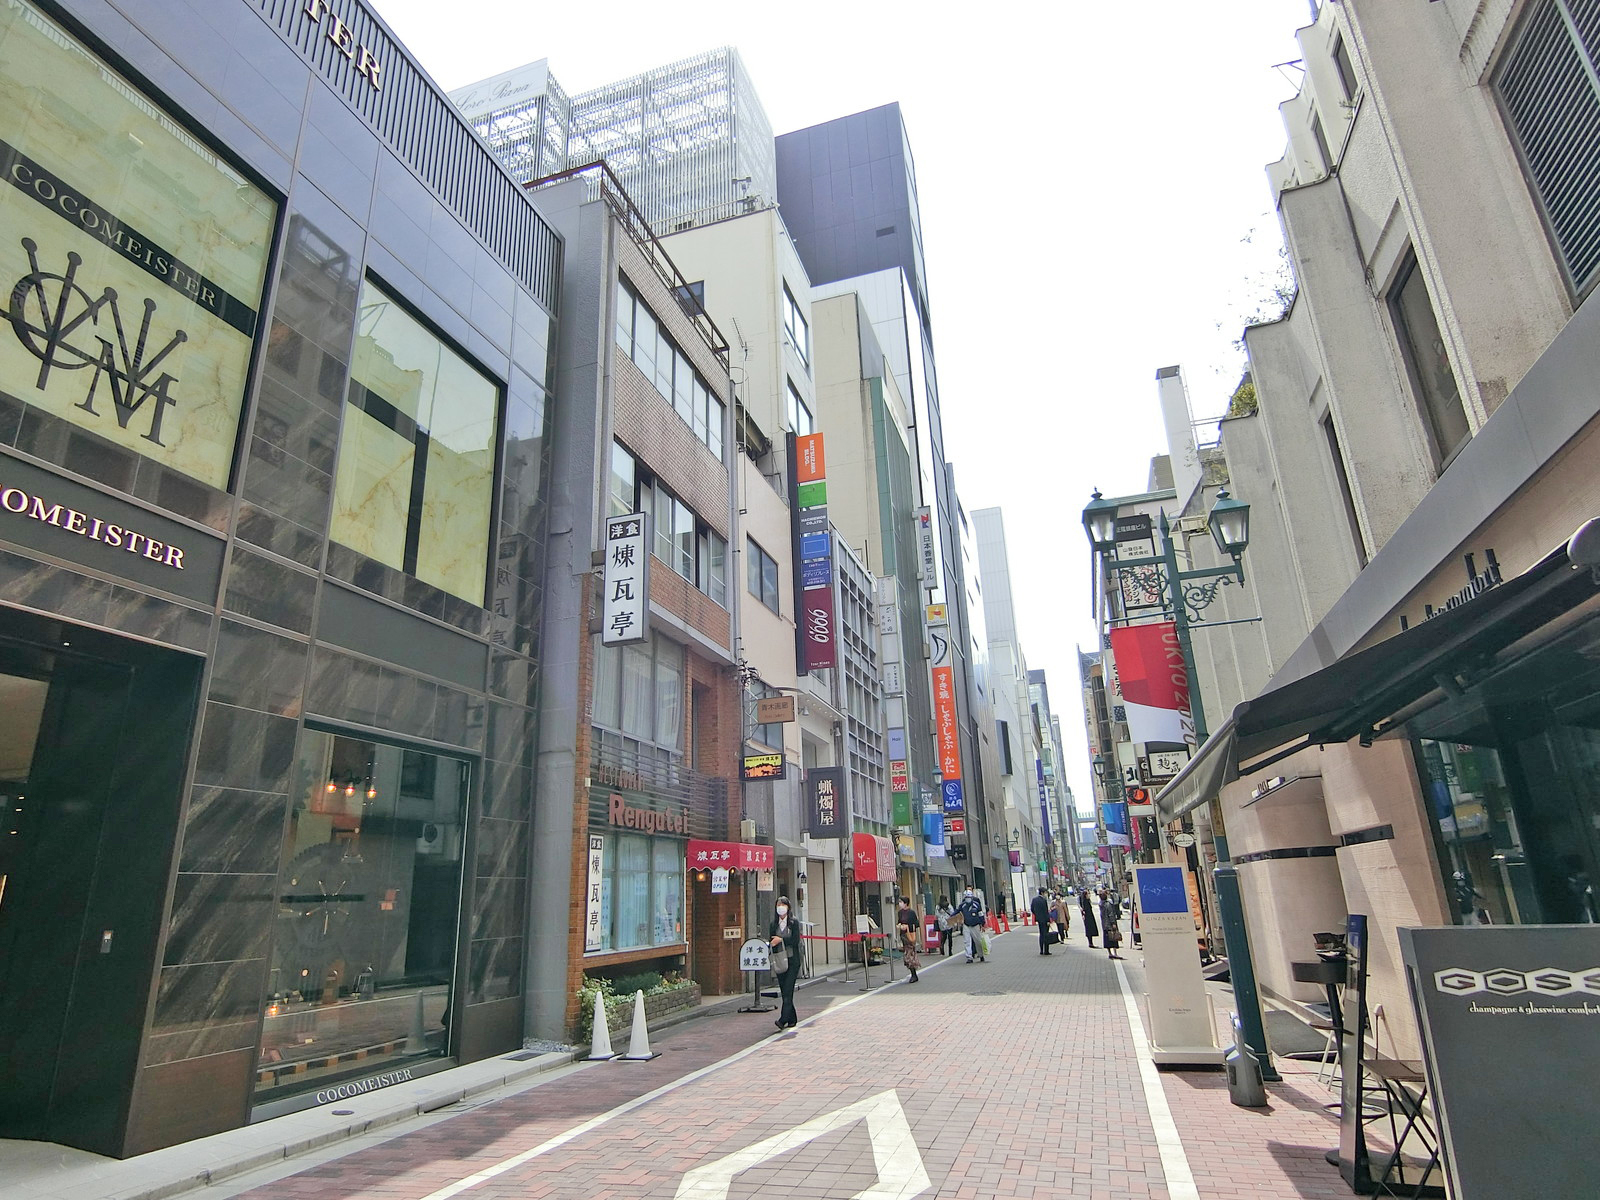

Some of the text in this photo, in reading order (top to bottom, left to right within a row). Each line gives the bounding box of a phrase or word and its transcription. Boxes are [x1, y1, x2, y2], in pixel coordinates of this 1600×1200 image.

[456, 80, 530, 111] Loro Piana
[10, 163, 216, 308] COCOMEISTER
[0, 483, 185, 570] OMEISTER
[611, 522, 639, 539] 洋食
[611, 544, 635, 637] 煉瓦亭
[609, 793, 688, 835] Rengatei
[697, 850, 731, 861] 煉瓦亭
[590, 855, 600, 932] 煉瓦亭
[743, 957, 768, 967] 煉瓦亭
[1469, 1001, 1517, 1015] champagne
[1525, 1001, 1566, 1015] glasswine
[316, 1069, 413, 1104] COCOMEISTER
